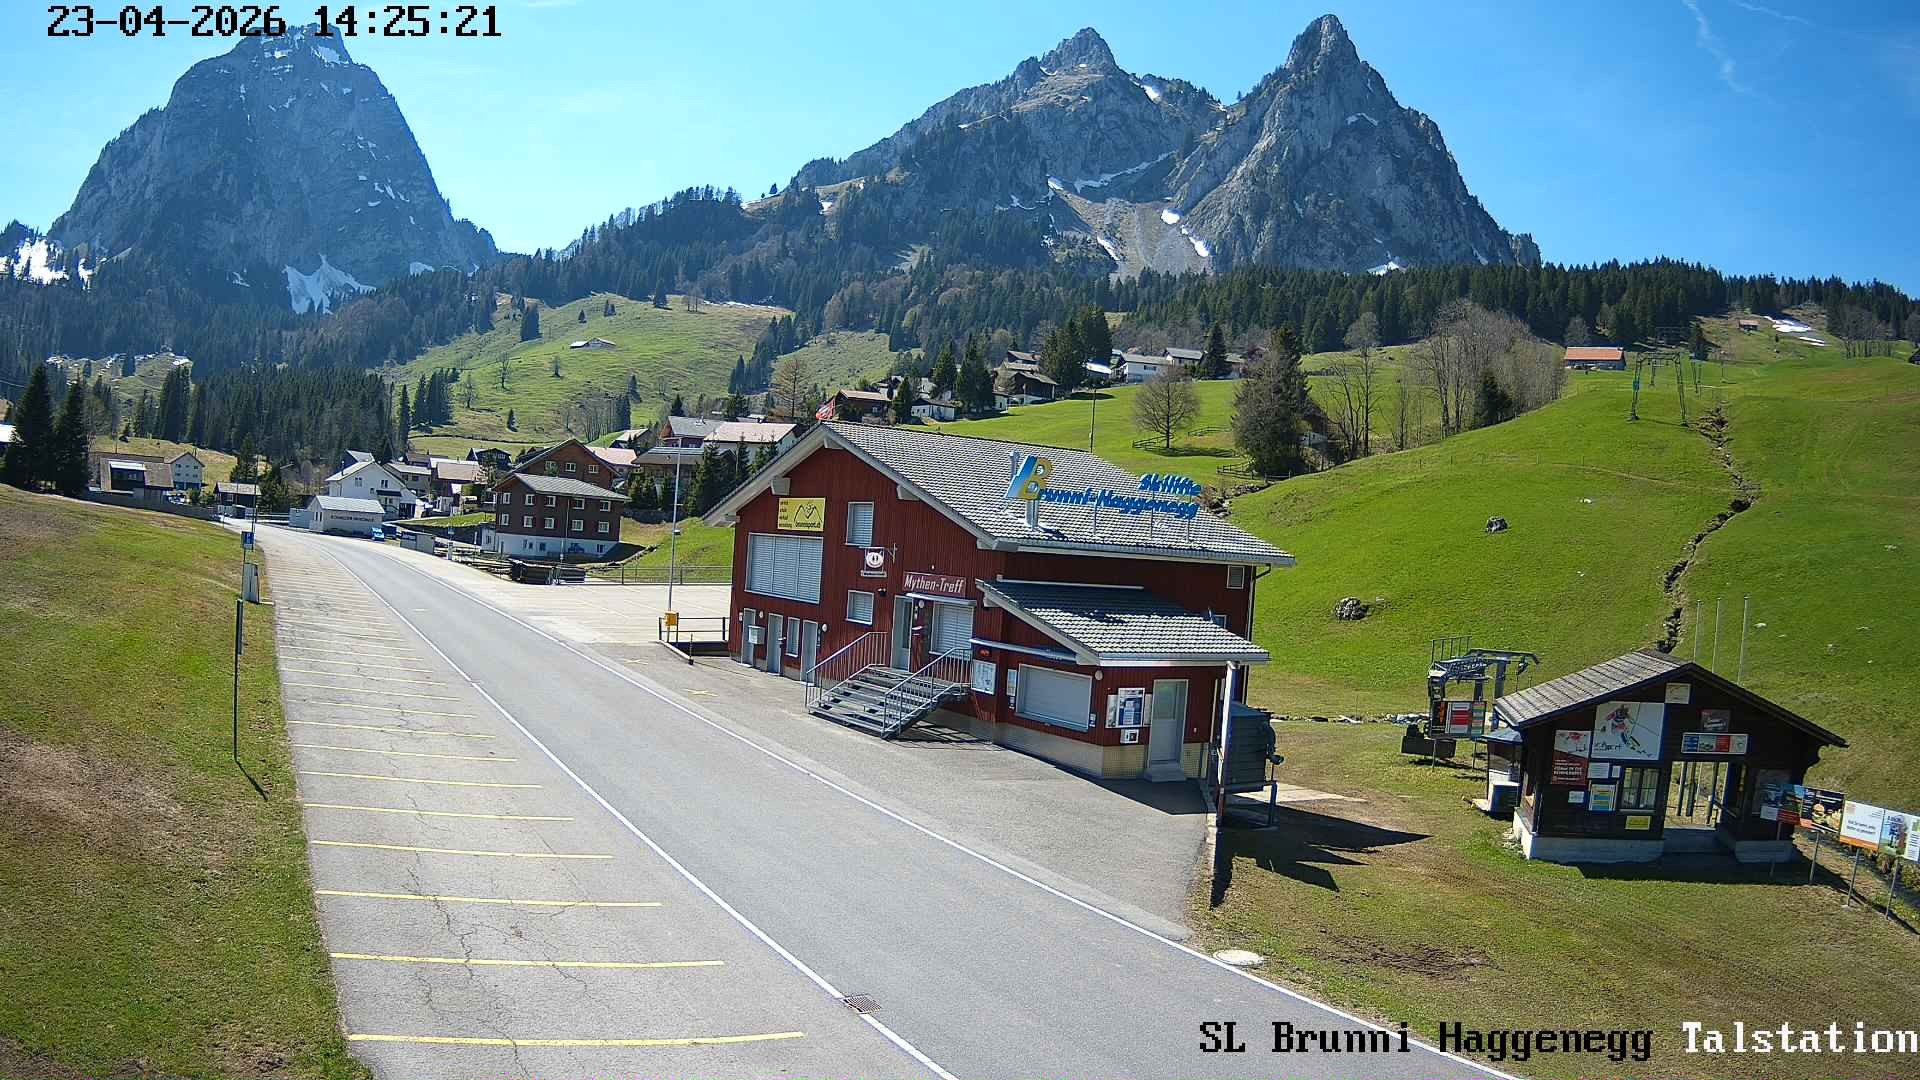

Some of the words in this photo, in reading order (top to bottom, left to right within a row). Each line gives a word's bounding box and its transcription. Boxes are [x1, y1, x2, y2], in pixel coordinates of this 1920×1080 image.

[1016, 456, 1202, 520] Brunni-Haggenegg
[1137, 473, 1202, 497] Skilifte
[904, 574, 964, 594] Mythen-Treff
